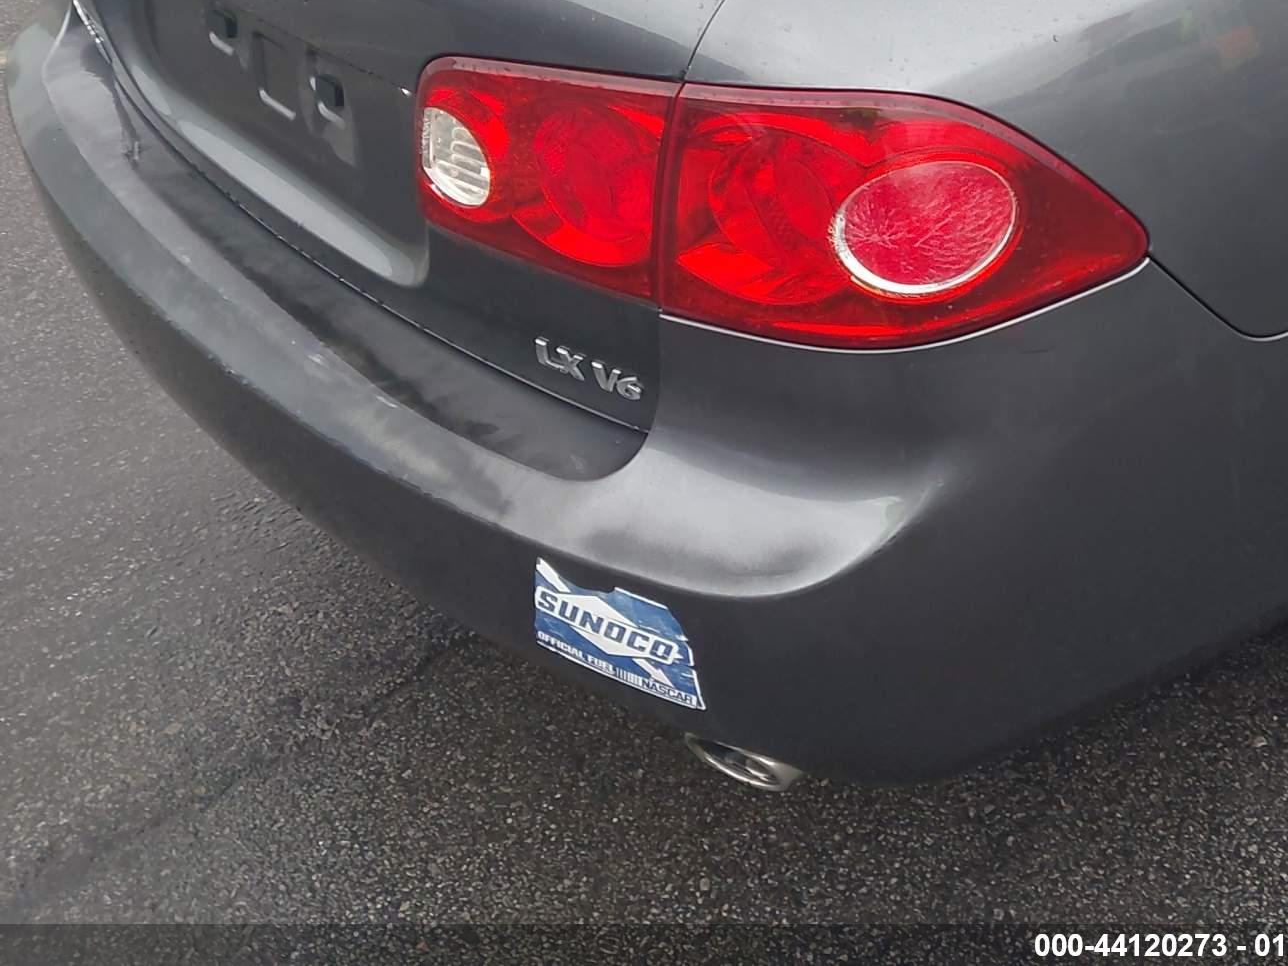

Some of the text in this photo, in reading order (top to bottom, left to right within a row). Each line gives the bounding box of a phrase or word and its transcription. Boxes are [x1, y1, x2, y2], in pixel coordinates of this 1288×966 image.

[534, 337, 643, 400] LX V6
[537, 590, 674, 660] SUNOCO
[641, 679, 694, 703] NASCAR
